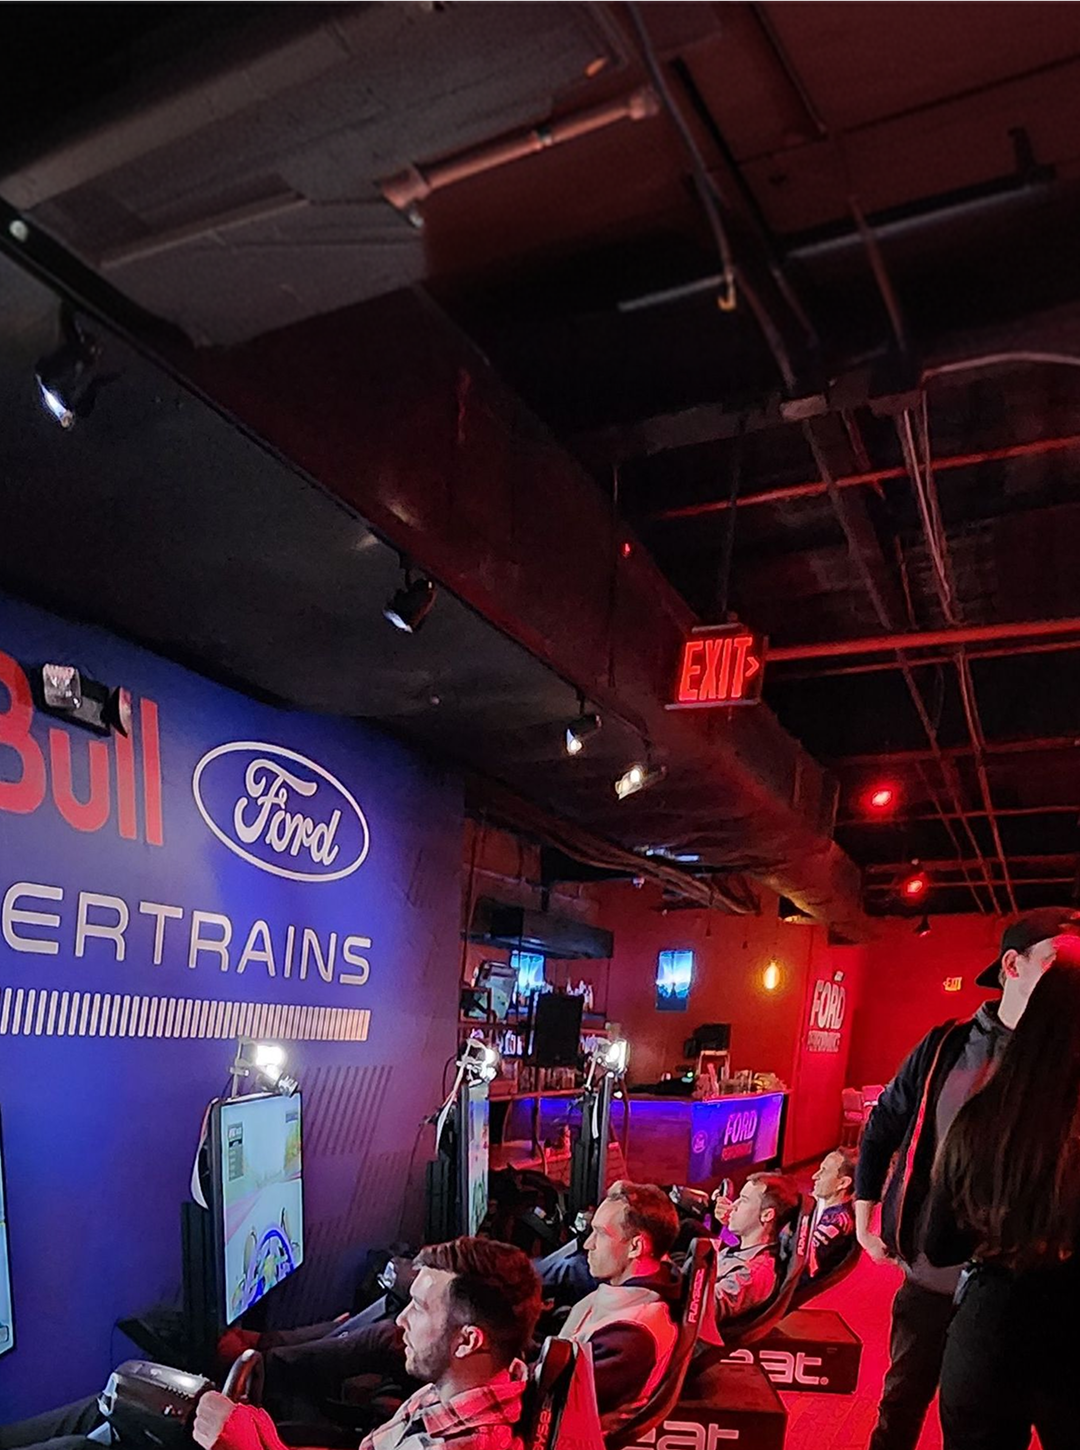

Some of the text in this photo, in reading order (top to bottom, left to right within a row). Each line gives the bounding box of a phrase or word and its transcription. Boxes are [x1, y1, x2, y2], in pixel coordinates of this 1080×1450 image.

[679, 637, 753, 701] EXIT
[234, 758, 342, 866] Ford
[809, 980, 846, 1030] FORD
[723, 1110, 758, 1146] FORD
